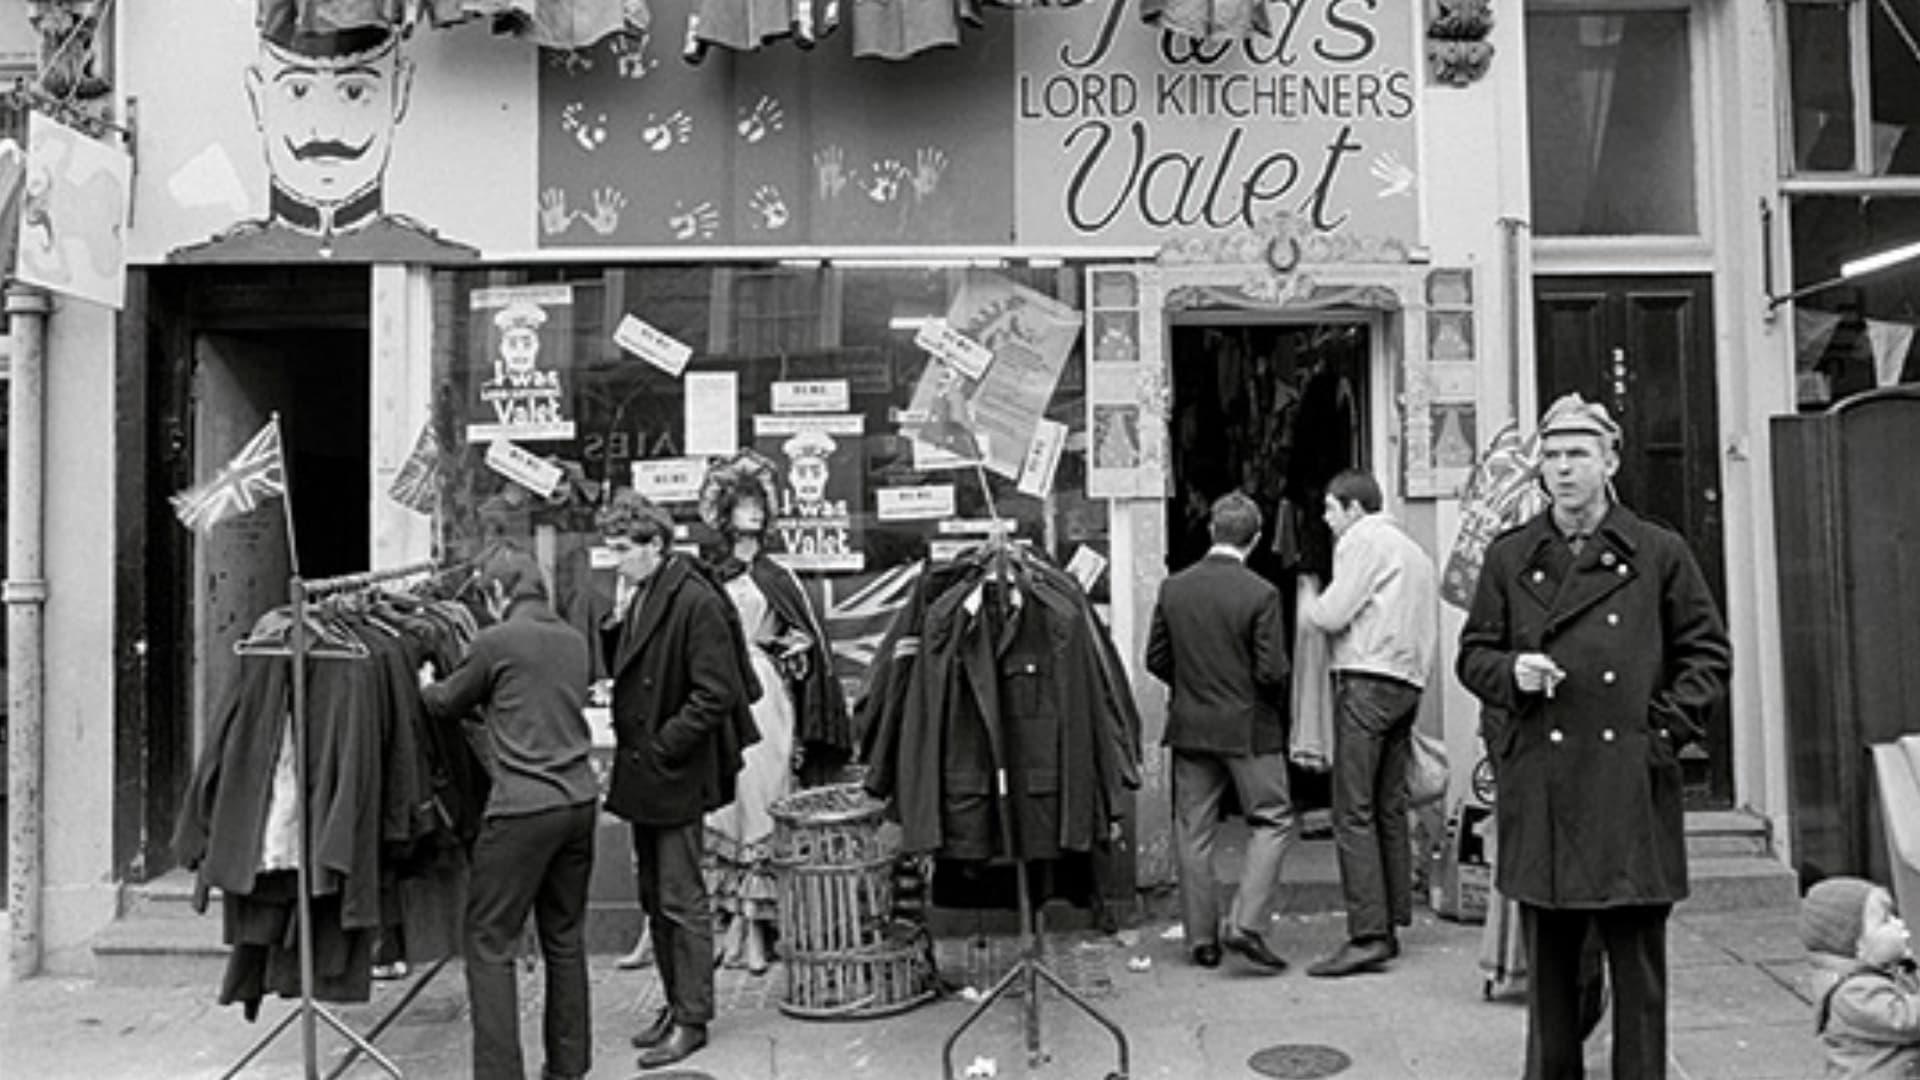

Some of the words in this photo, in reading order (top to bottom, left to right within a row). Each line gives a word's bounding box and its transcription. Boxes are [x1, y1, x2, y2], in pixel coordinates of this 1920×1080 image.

[1020, 73, 1138, 119] LORD
[1063, 120, 1362, 233] Valet
[492, 396, 561, 424] Valet
[781, 527, 849, 554] Valet
